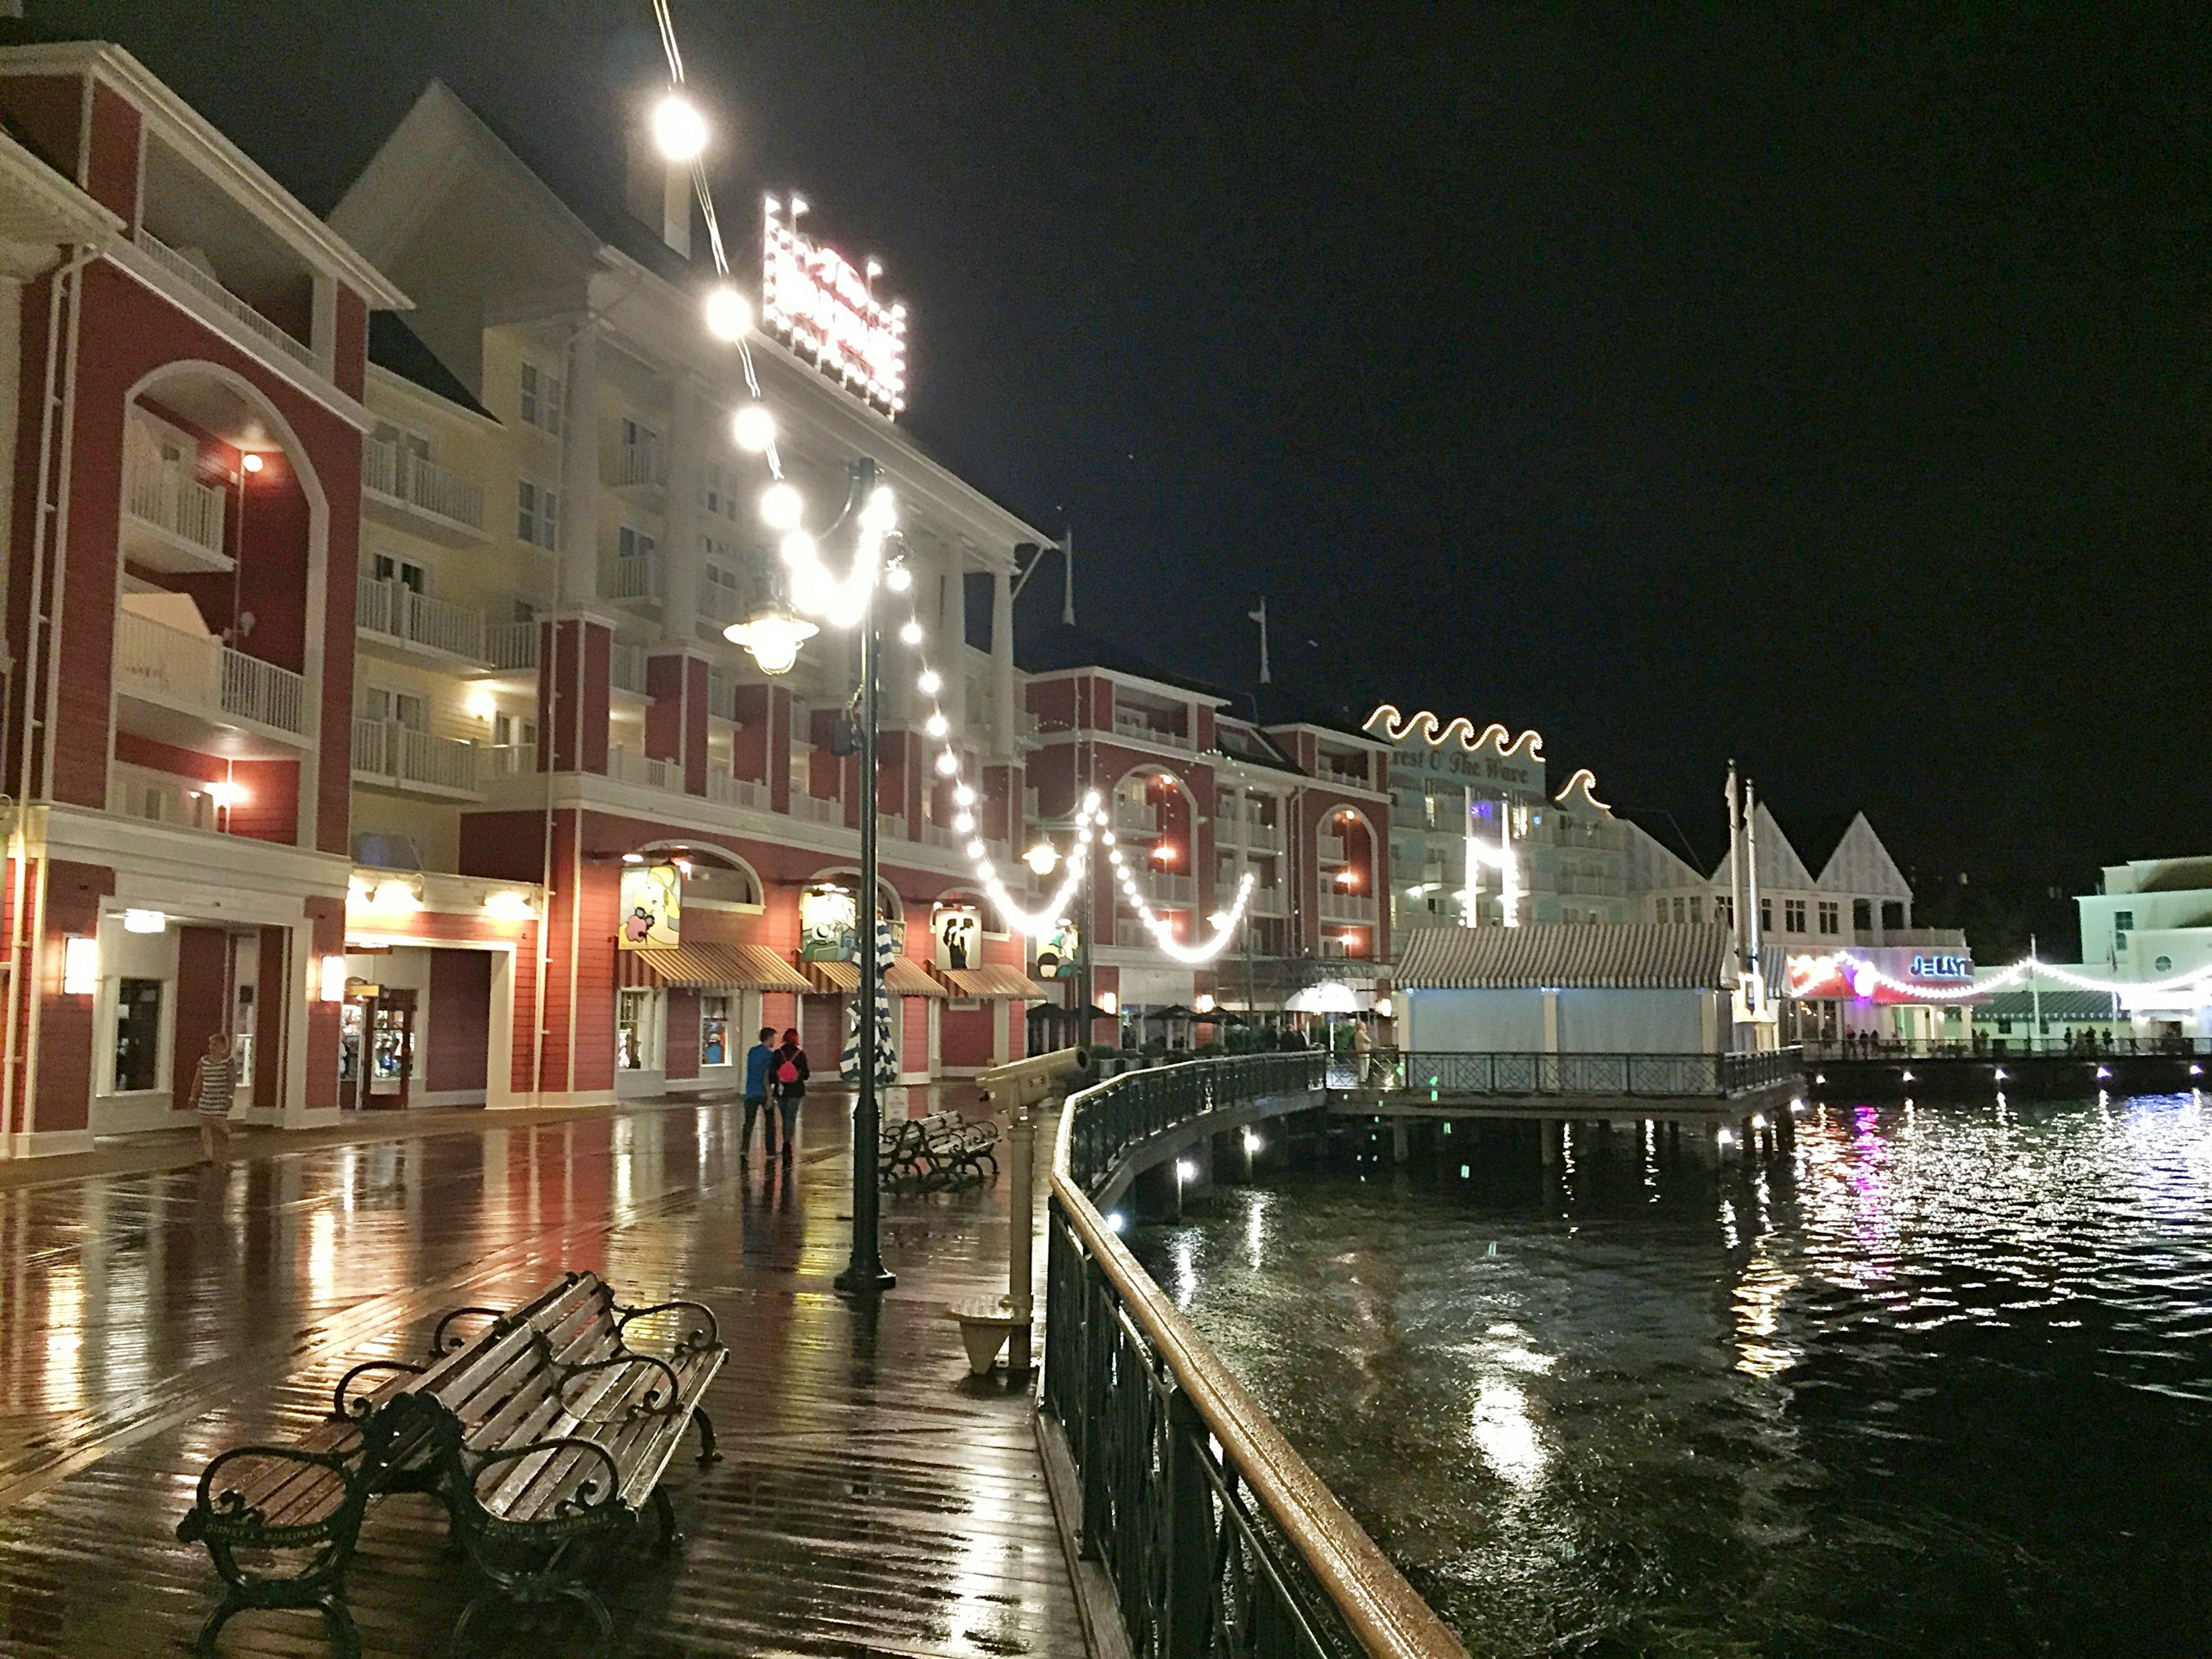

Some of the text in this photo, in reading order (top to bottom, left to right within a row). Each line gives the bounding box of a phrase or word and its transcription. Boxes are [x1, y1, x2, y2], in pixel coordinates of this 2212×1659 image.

[1392, 751, 1424, 768] rest
[1449, 751, 1480, 777] The
[1486, 757, 1528, 784] Wave
